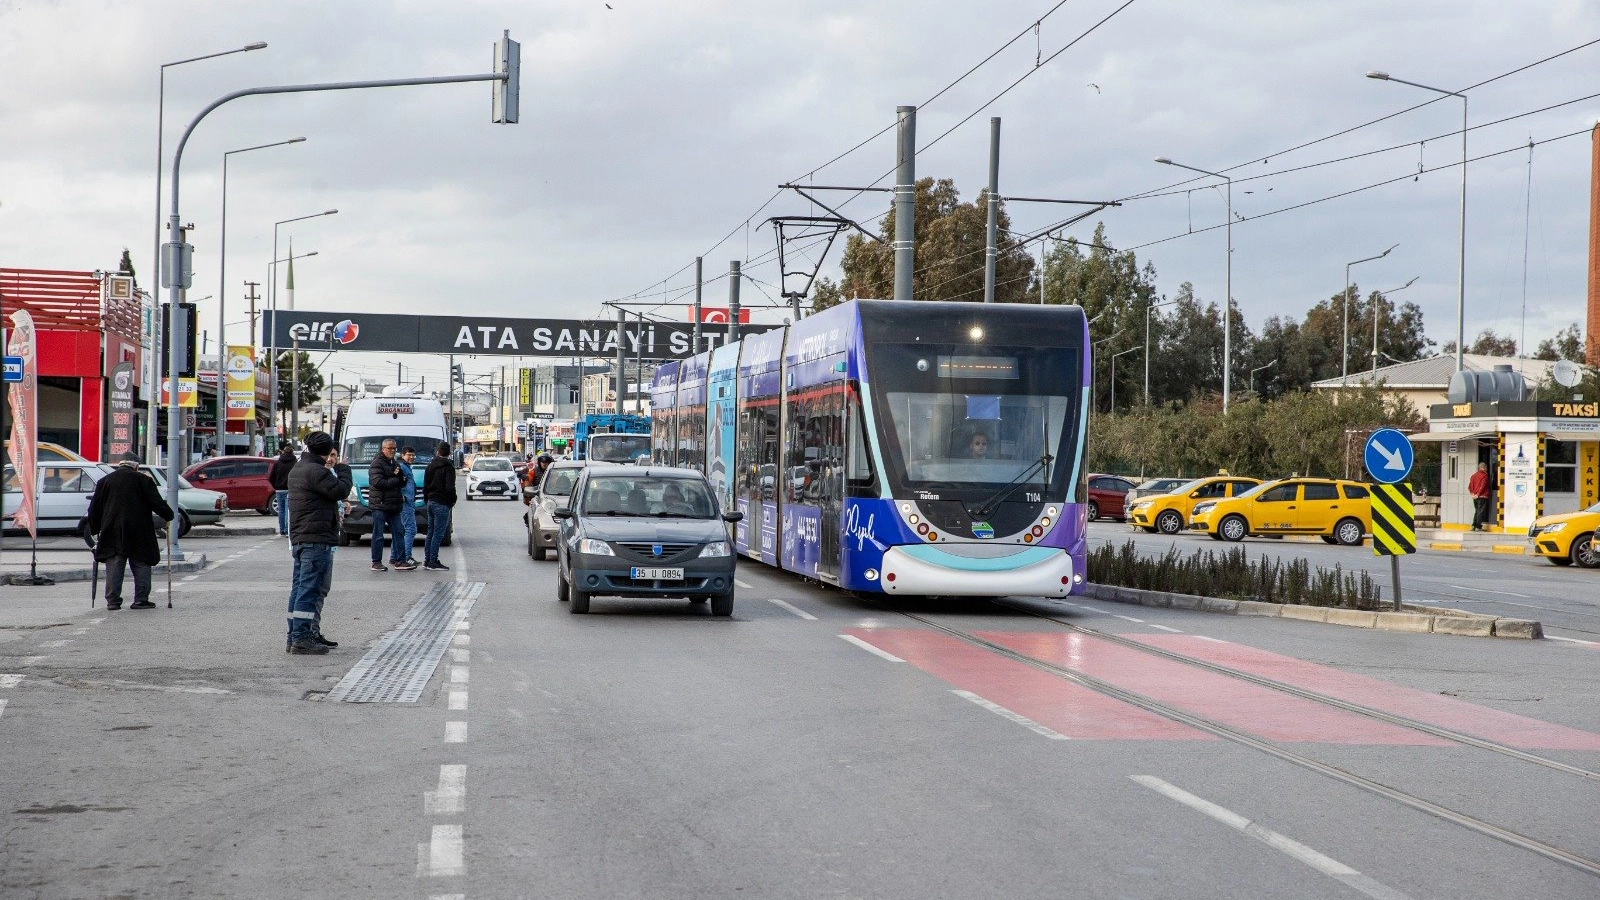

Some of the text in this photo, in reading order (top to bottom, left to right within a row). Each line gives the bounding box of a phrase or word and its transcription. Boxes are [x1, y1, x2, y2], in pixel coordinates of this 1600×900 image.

[289, 322, 333, 342] elf
[454, 325, 519, 349] ATA
[532, 325, 655, 353] SANAYİ
[1553, 402, 1599, 417] TAKSİ
[1025, 493, 1041, 502] T104
[636, 569, 681, 578] 35 U 0894
